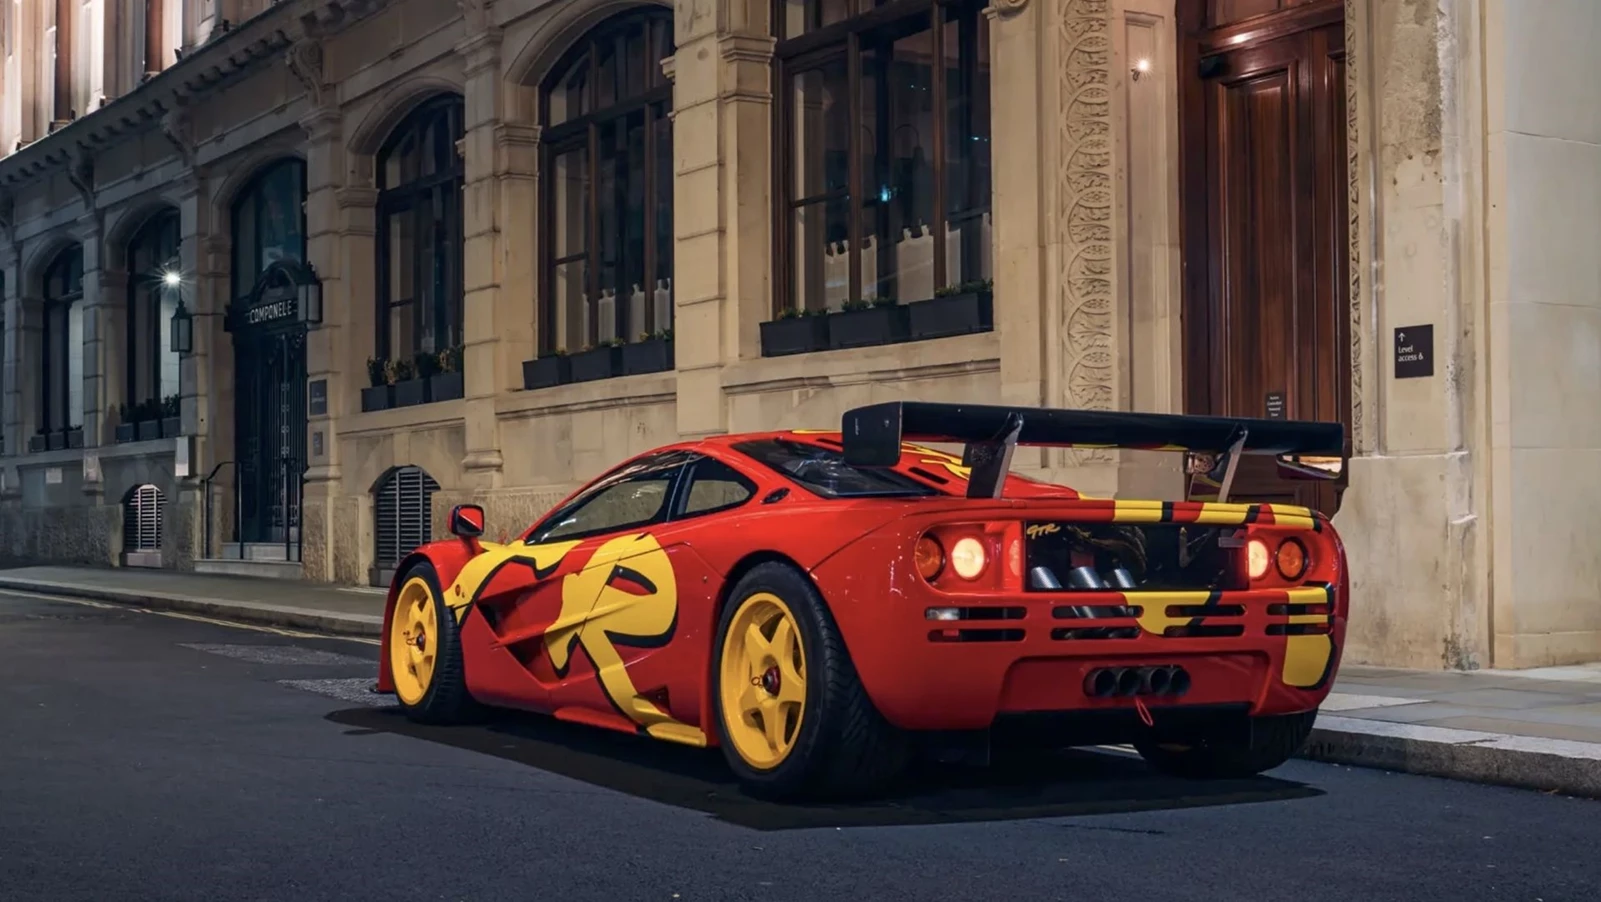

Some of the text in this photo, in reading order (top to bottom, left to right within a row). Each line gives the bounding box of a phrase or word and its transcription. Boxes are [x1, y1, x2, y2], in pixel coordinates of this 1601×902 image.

[1398, 345, 1414, 354] Level
[1398, 354, 1418, 362] access
[1026, 523, 1061, 540] GTR
